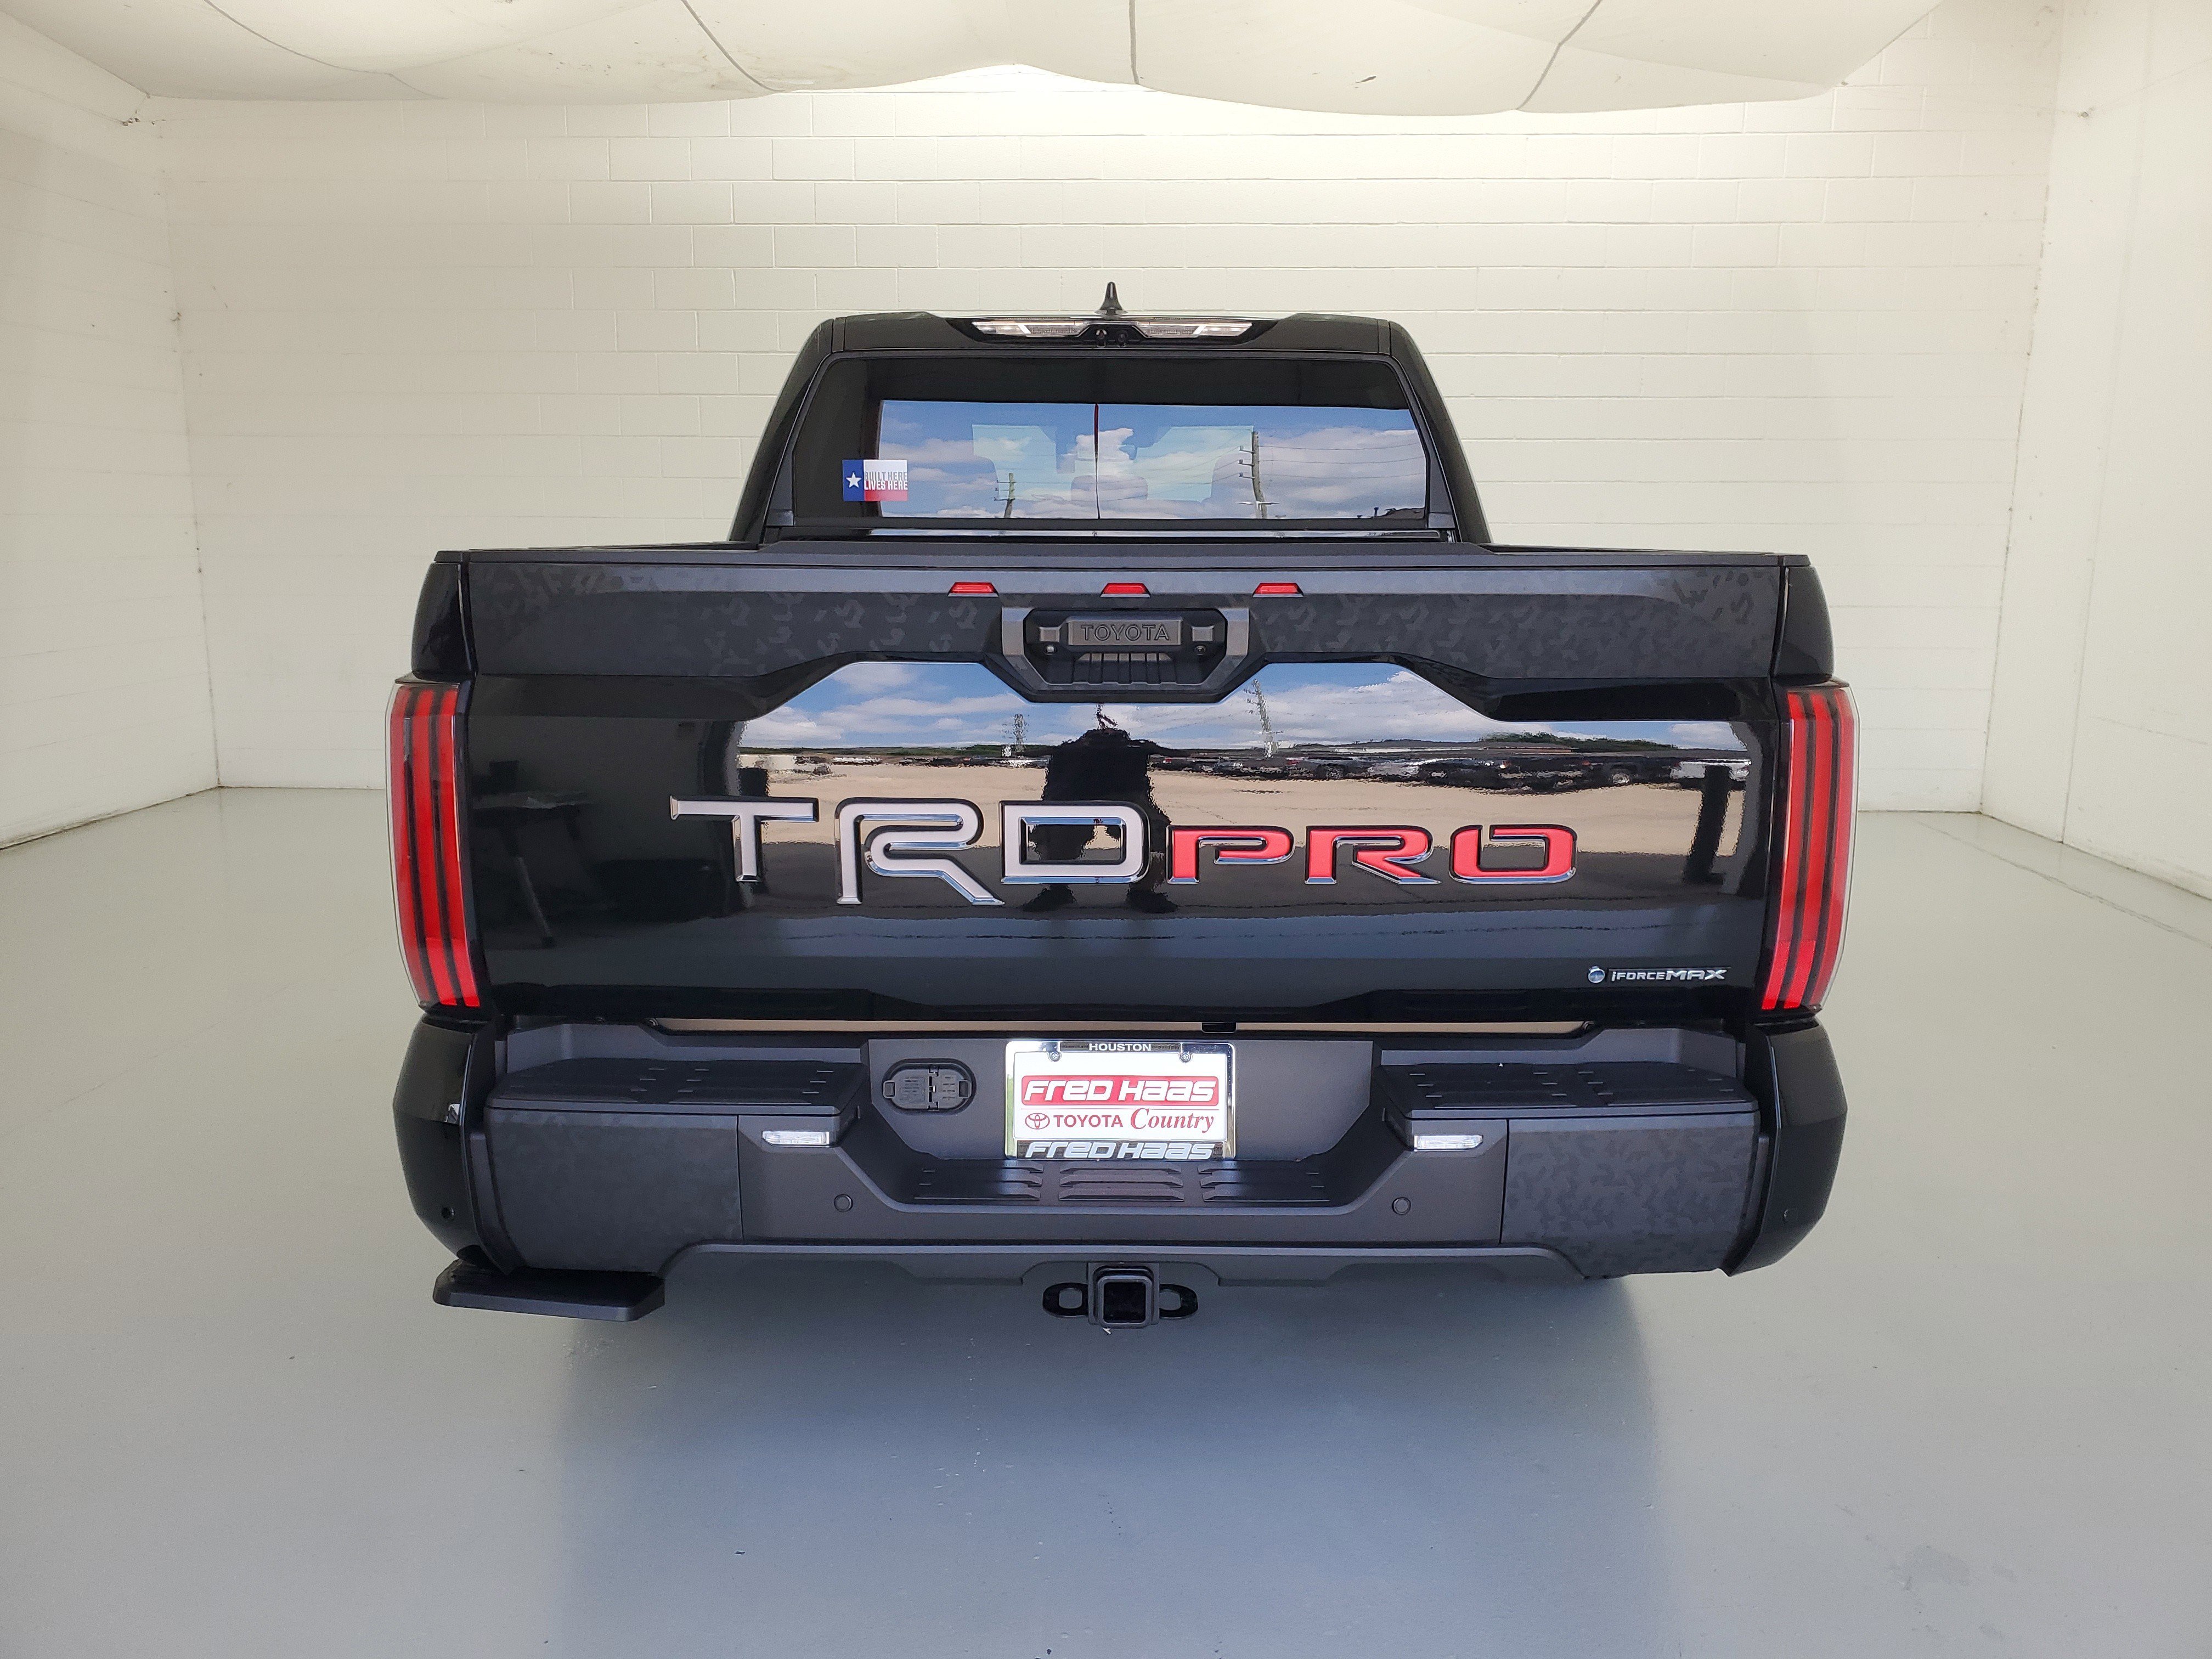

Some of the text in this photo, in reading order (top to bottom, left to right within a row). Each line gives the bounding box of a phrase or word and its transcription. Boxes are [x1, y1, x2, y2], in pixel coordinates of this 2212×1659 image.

[865, 471, 907, 481] BUILT HERE
[864, 481, 908, 490] LIVES HERE
[1081, 624, 1170, 641] TOYOTA
[670, 795, 1577, 905] TRD PRO
[1089, 1043, 1151, 1052] HOUSTON
[1053, 1108, 1214, 1133] TOYOTA Country
